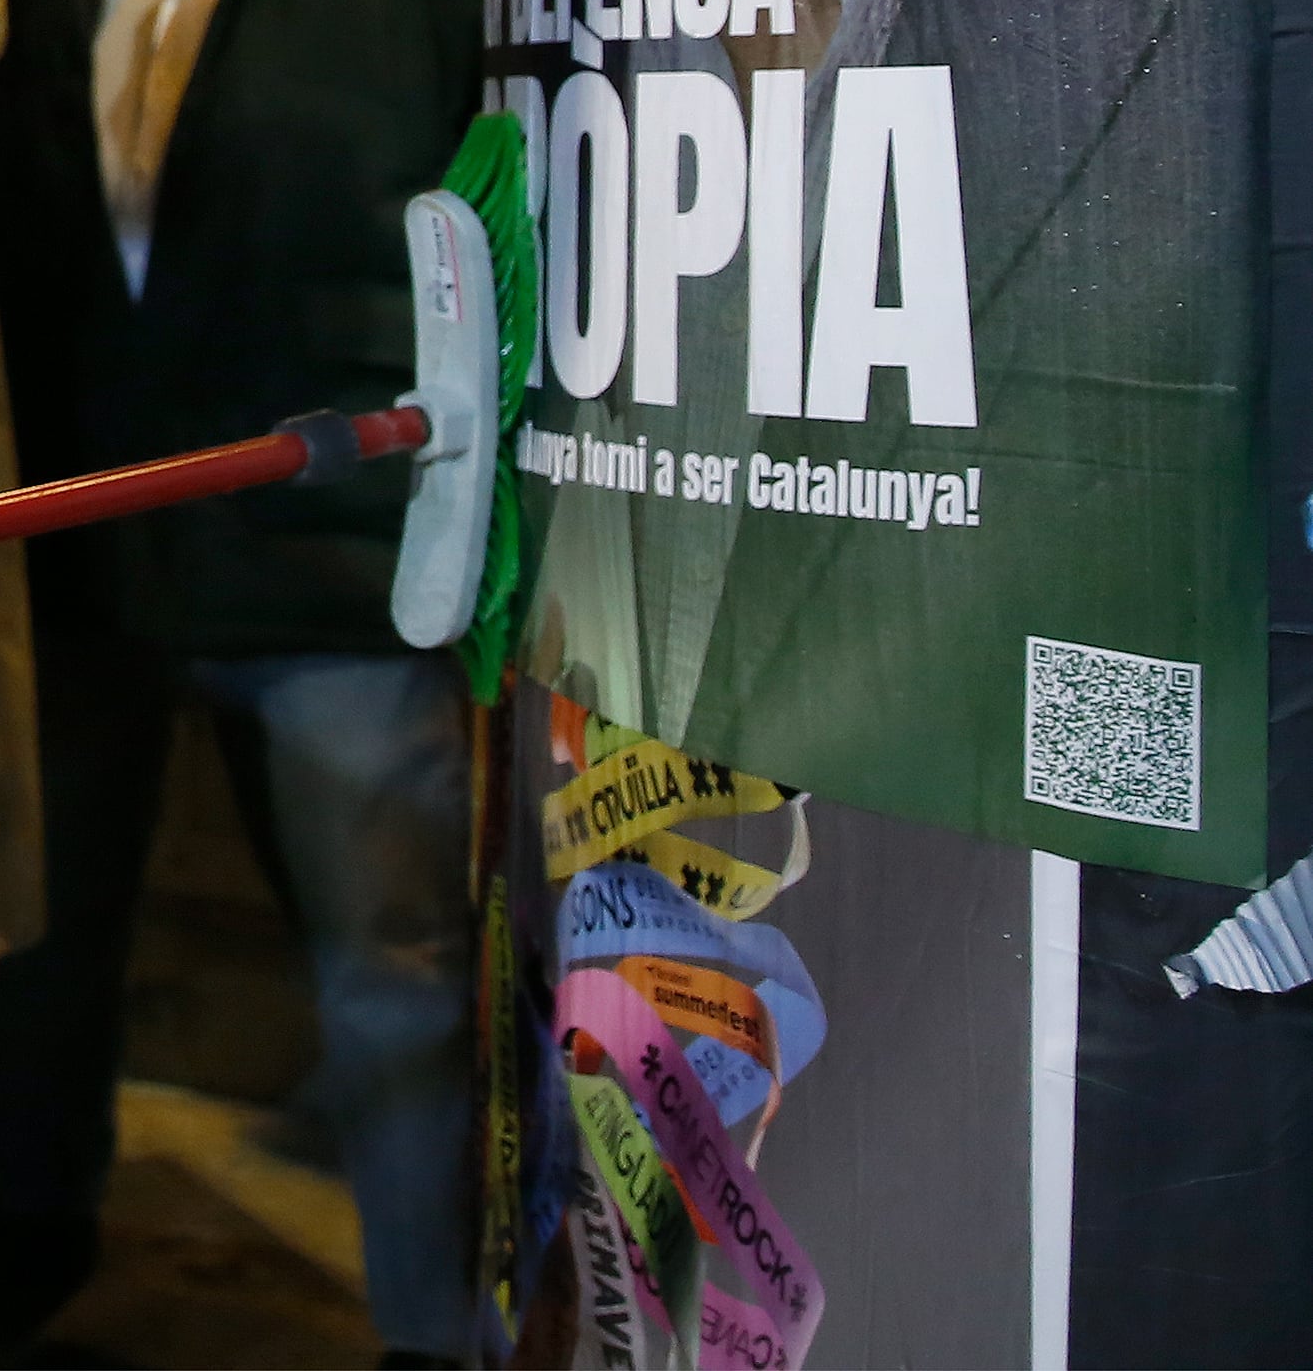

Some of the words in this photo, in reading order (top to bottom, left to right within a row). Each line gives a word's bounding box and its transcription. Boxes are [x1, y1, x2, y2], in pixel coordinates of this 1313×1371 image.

[485, 19, 978, 427] RÒPIA
[582, 431, 648, 494] torni
[654, 449, 675, 497] a
[681, 452, 739, 506] ser
[748, 452, 981, 531] Catalunya!
